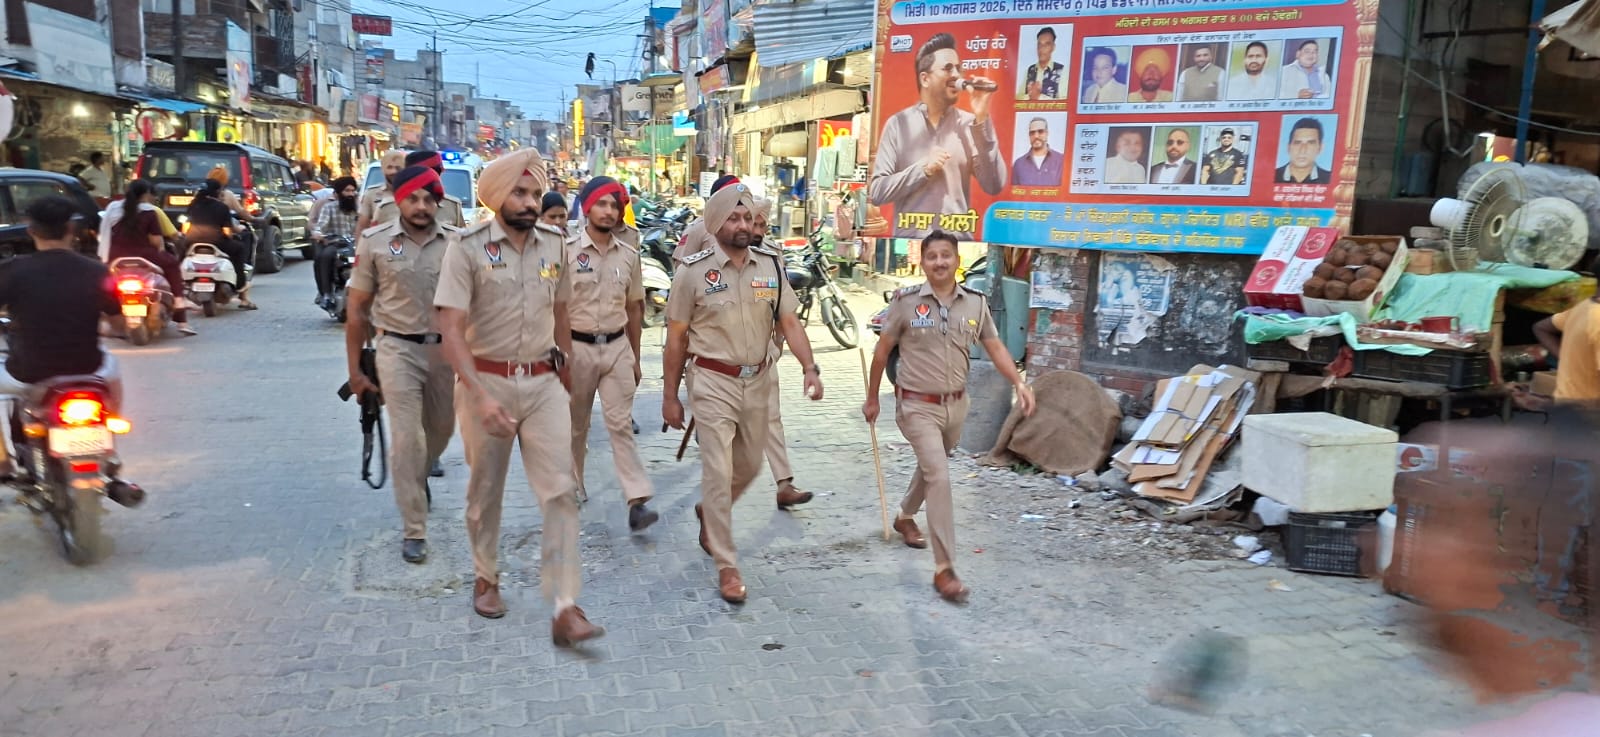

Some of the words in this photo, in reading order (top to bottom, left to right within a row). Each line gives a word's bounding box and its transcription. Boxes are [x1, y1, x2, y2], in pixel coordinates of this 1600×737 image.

[904, 3, 926, 17] ਮਿਤੀ
[930, 6, 940, 16] 10
[943, 3, 976, 15] ਅਗਸਤ
[980, 1, 1010, 14] 2026,
[1181, 16, 1209, 26] ਅਗਸਤ
[991, 34, 1008, 49] ਰਹੇ
[961, 58, 1002, 69] ਕਲਾਕਾਰ
[898, 212, 935, 231] ਮਾਸ਼ਾ
[938, 209, 979, 233] ਅਲੀ
